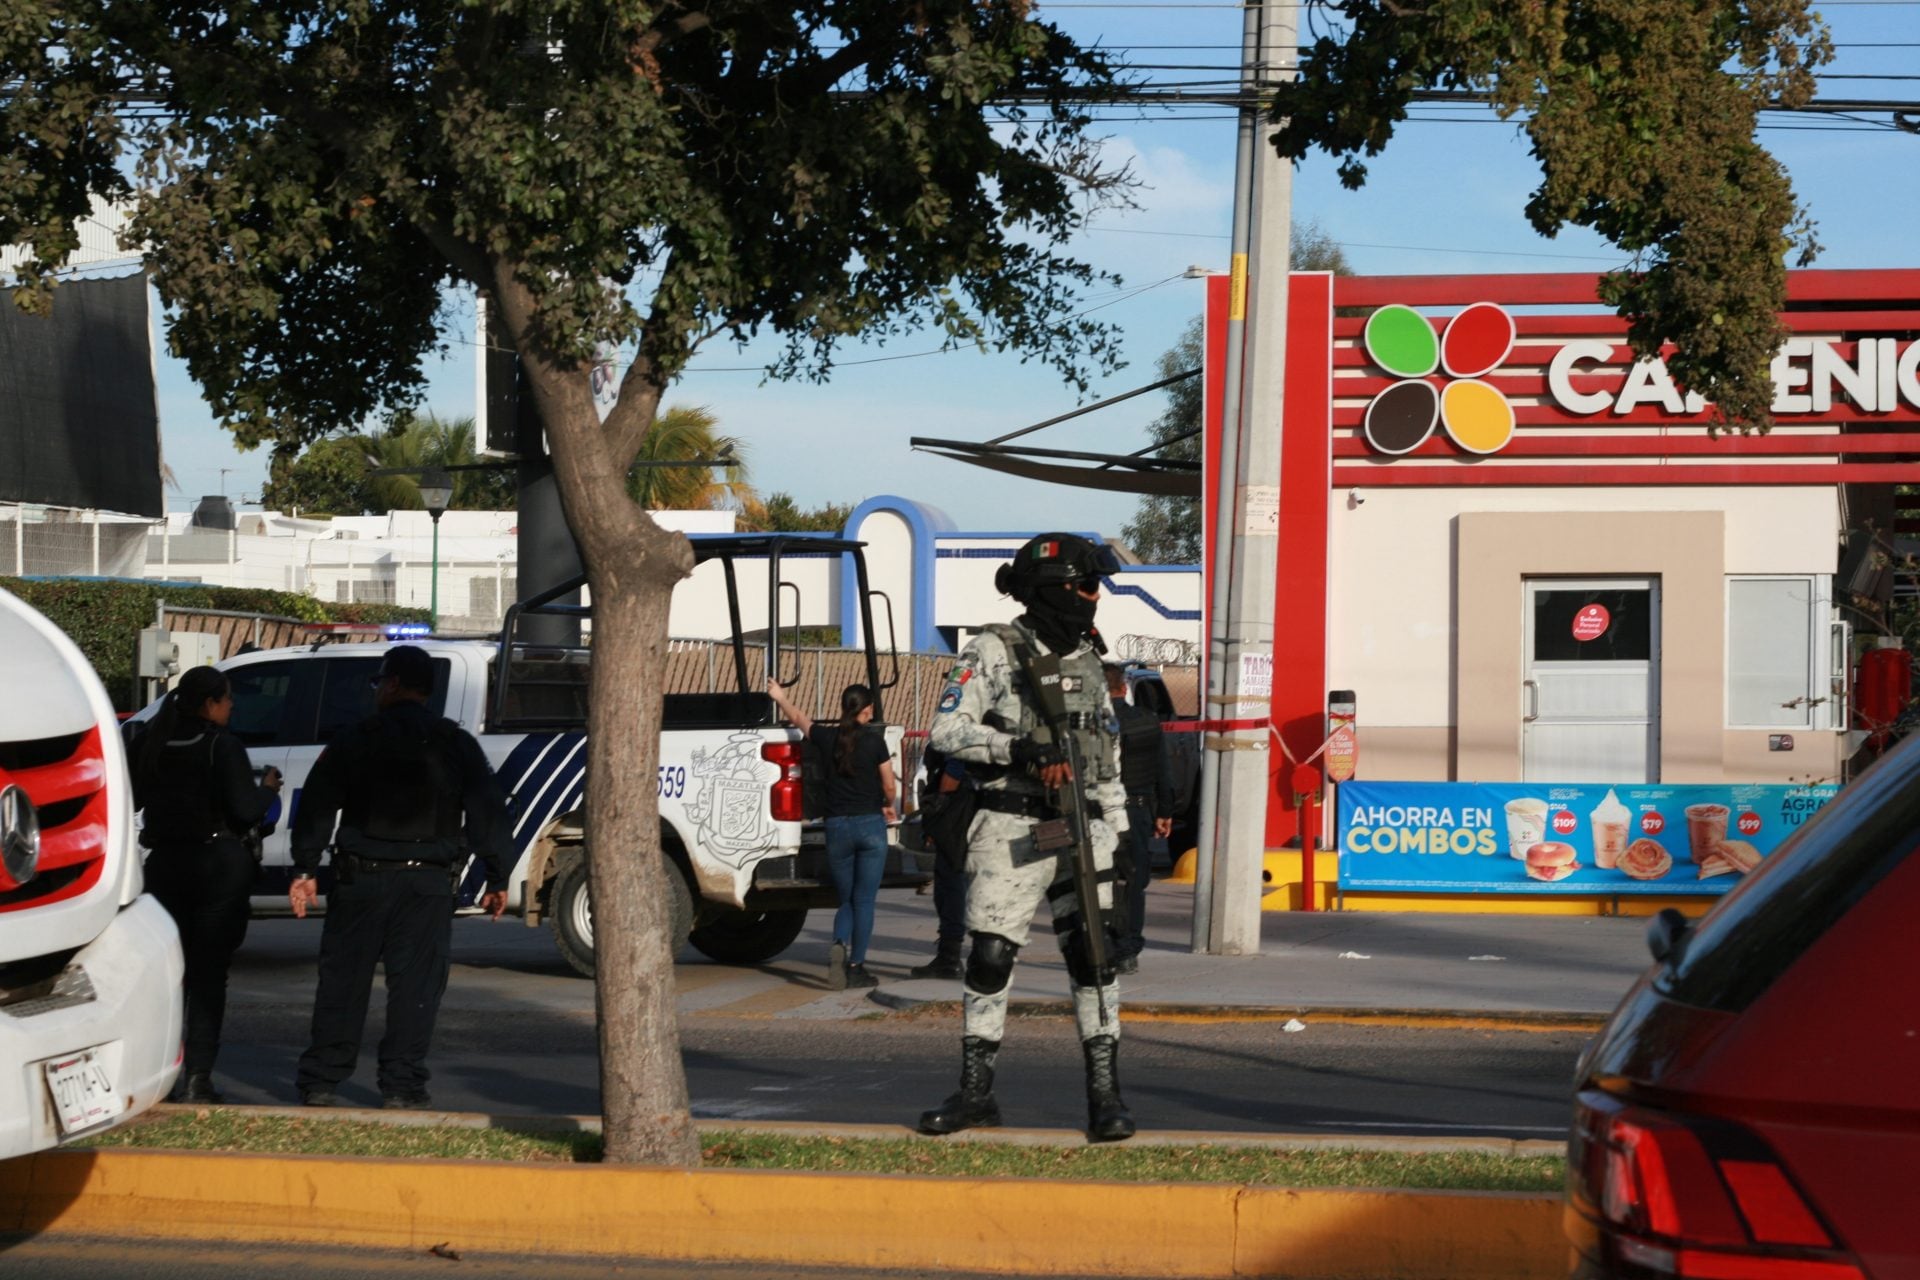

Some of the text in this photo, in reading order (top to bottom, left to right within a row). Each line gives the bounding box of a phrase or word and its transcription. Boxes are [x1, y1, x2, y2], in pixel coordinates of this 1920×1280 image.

[1548, 337, 1920, 414] CAENI
[1350, 806, 1492, 828] AHORRA EN
[1553, 817, 1577, 828] $109
[1780, 812, 1801, 825] TU
[1641, 819, 1662, 830] $79
[1738, 819, 1760, 830] $99
[1346, 827, 1497, 855] COMBOS
